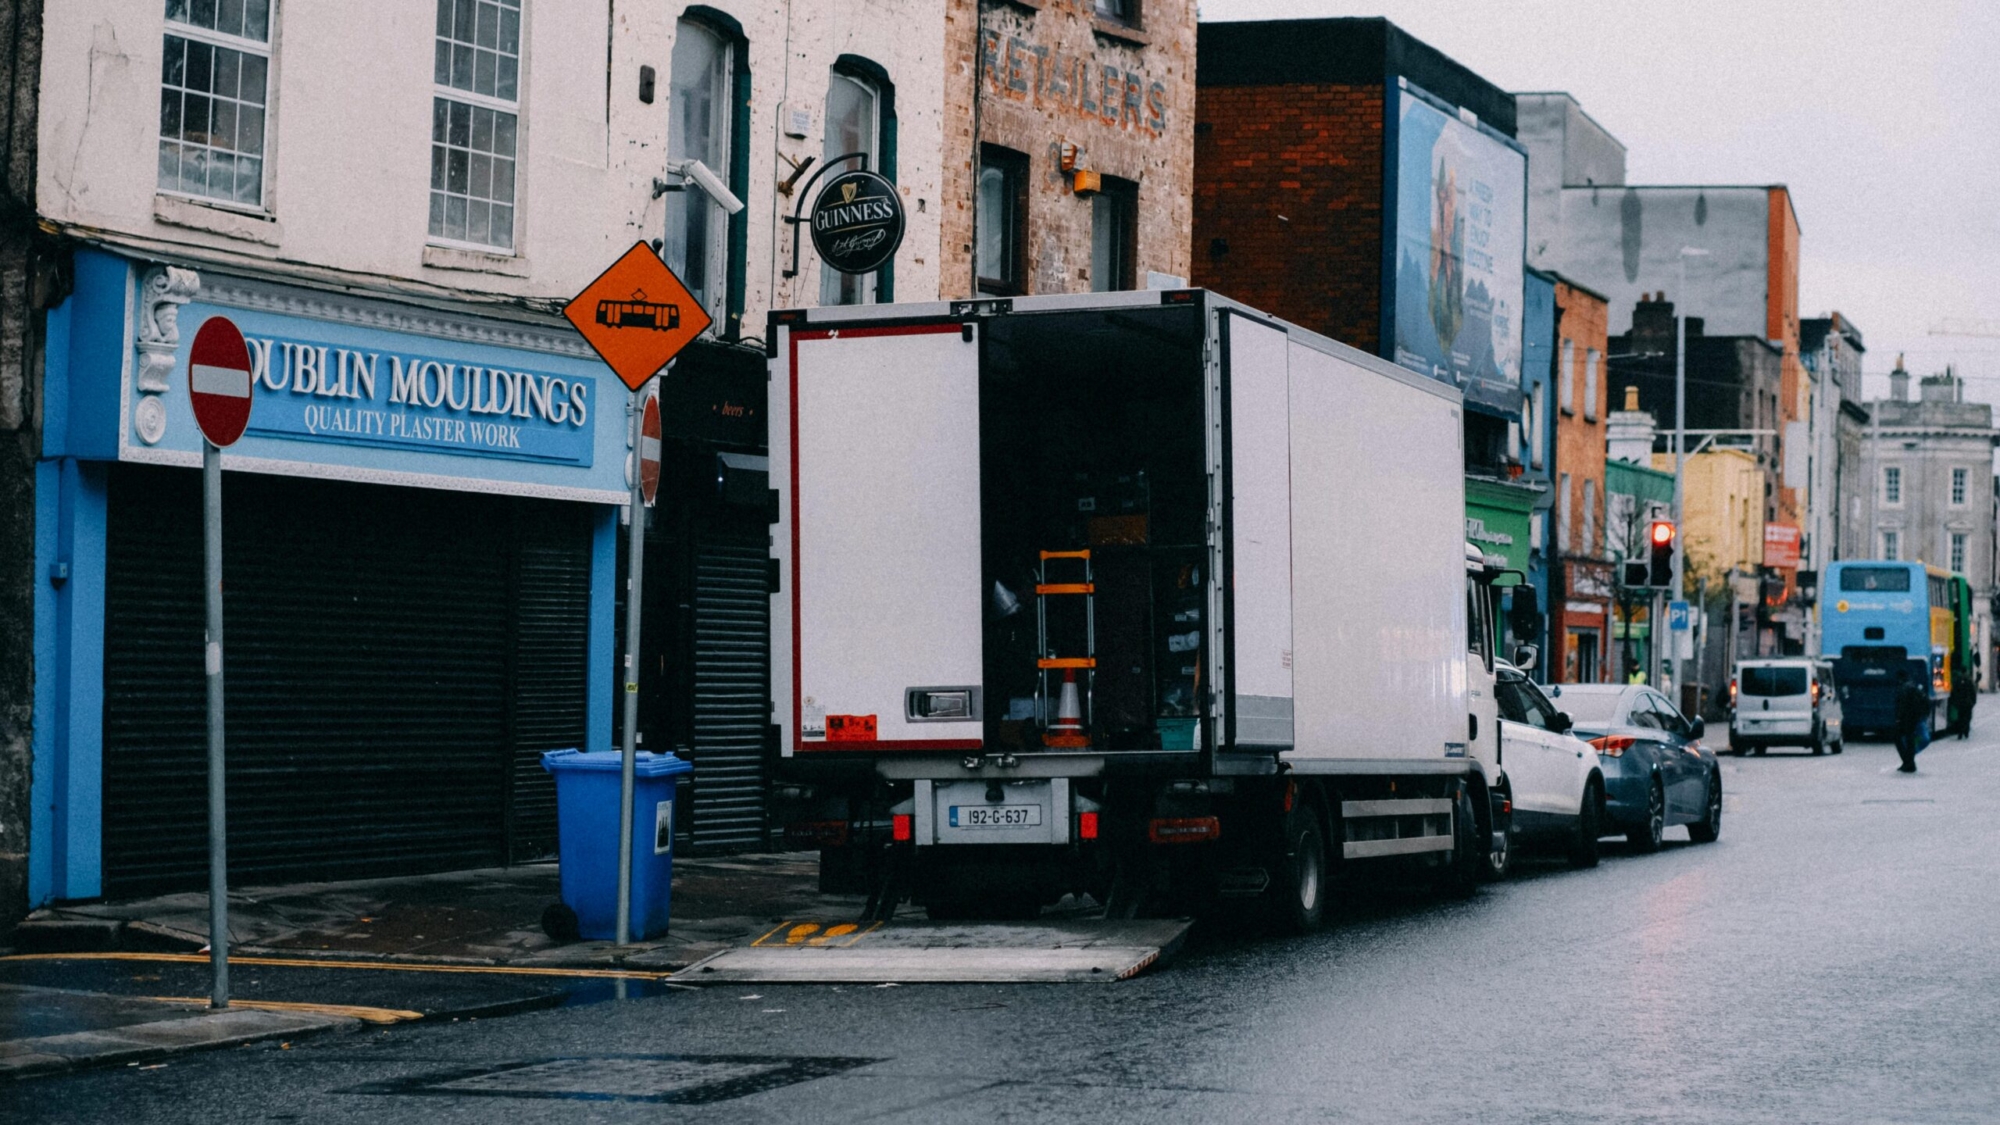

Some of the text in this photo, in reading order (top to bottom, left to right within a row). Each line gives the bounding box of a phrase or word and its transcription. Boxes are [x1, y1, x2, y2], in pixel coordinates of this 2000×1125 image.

[815, 201, 894, 231] GUINNESS
[388, 355, 588, 428] MOULDINGS
[722, 401, 744, 417] beers
[304, 405, 521, 449] QUALITY PLASTER WORK
[1671, 609, 1687, 622] P1
[969, 809, 1027, 825] 192-G-637
